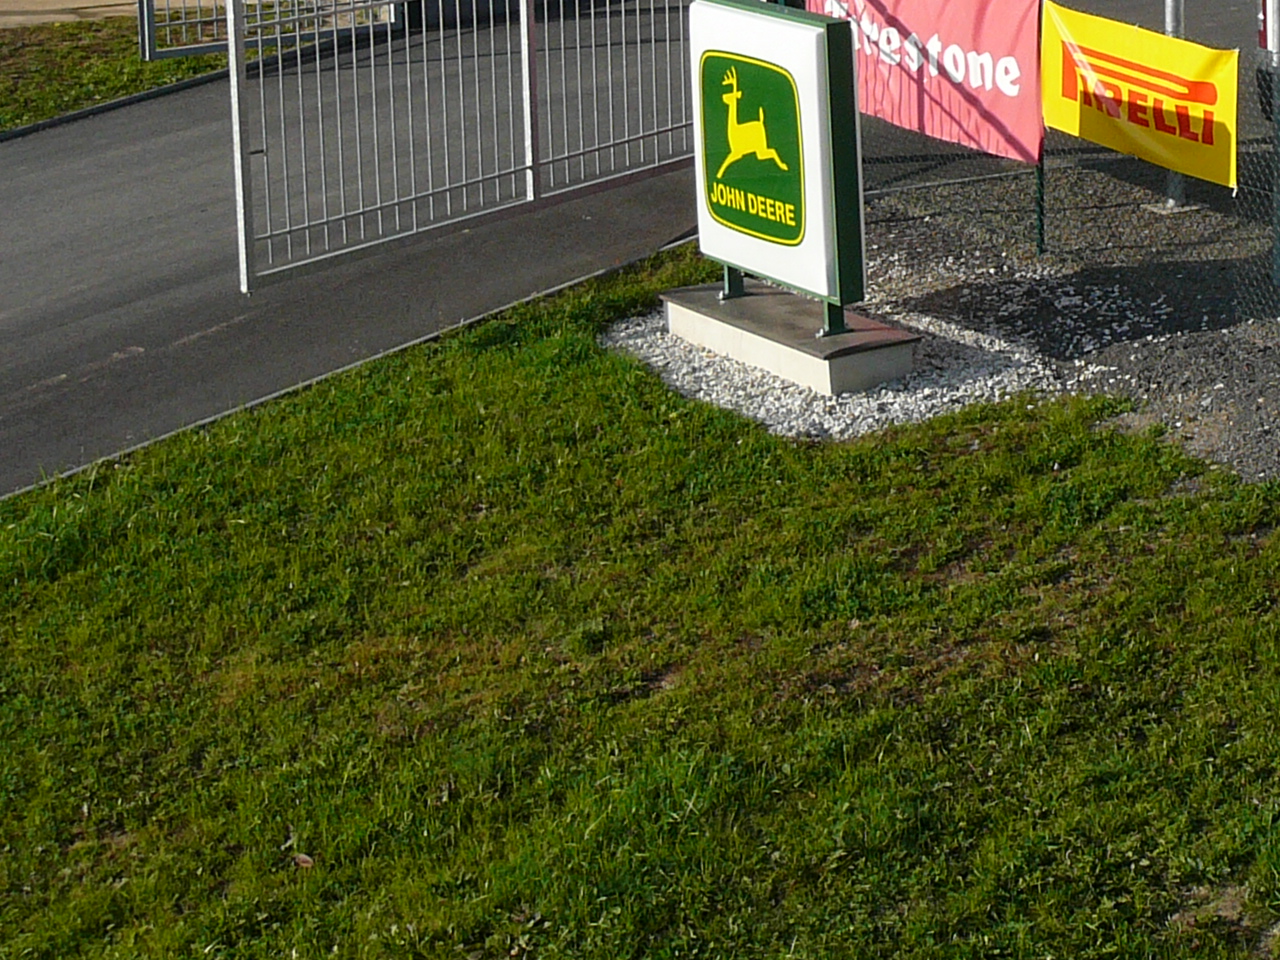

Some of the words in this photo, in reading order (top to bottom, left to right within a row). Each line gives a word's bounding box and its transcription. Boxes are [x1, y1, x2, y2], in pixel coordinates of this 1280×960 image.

[1061, 40, 1218, 146] PIRELLI
[710, 181, 746, 212] JOHN
[747, 192, 797, 227] DEERE
